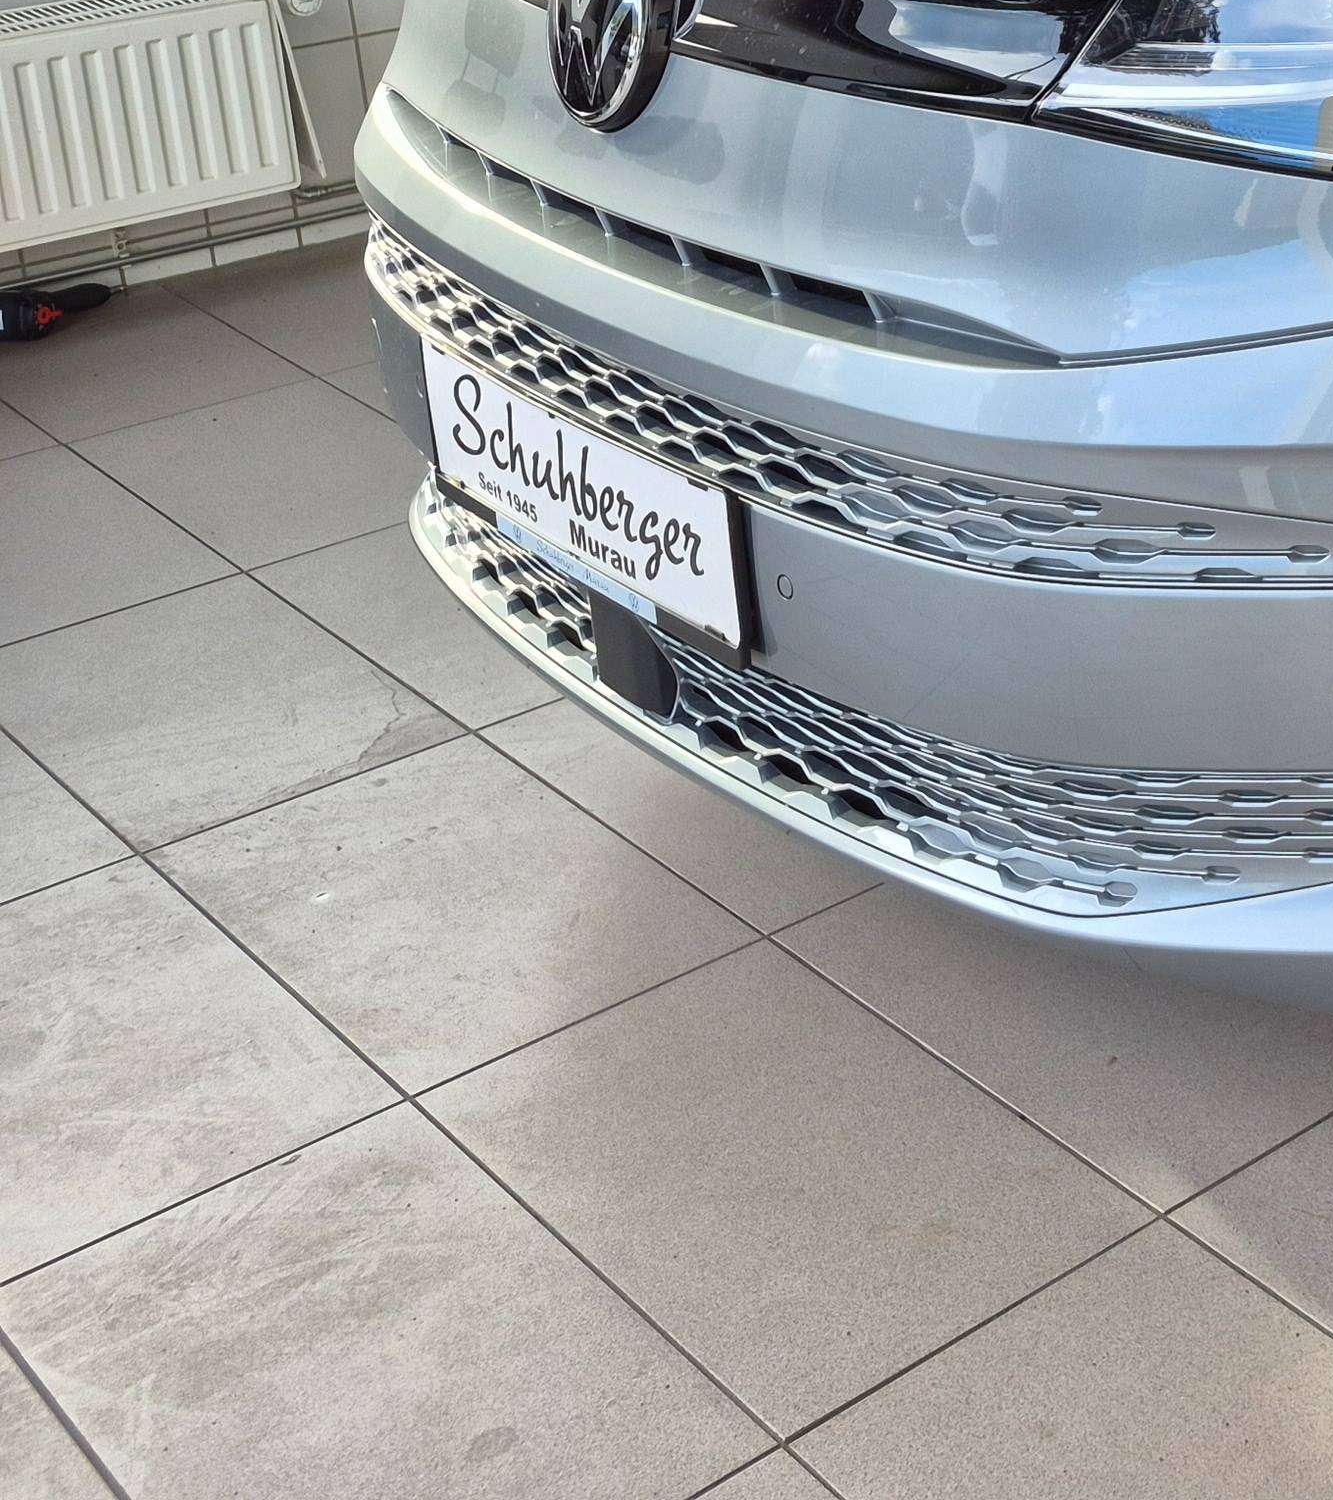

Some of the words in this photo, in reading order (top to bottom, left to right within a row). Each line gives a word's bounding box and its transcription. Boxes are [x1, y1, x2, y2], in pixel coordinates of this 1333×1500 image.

[452, 373, 705, 581] Schuhberger
[478, 471, 502, 501] Seit
[506, 489, 538, 522] 1945
[569, 519, 637, 580] Murau
